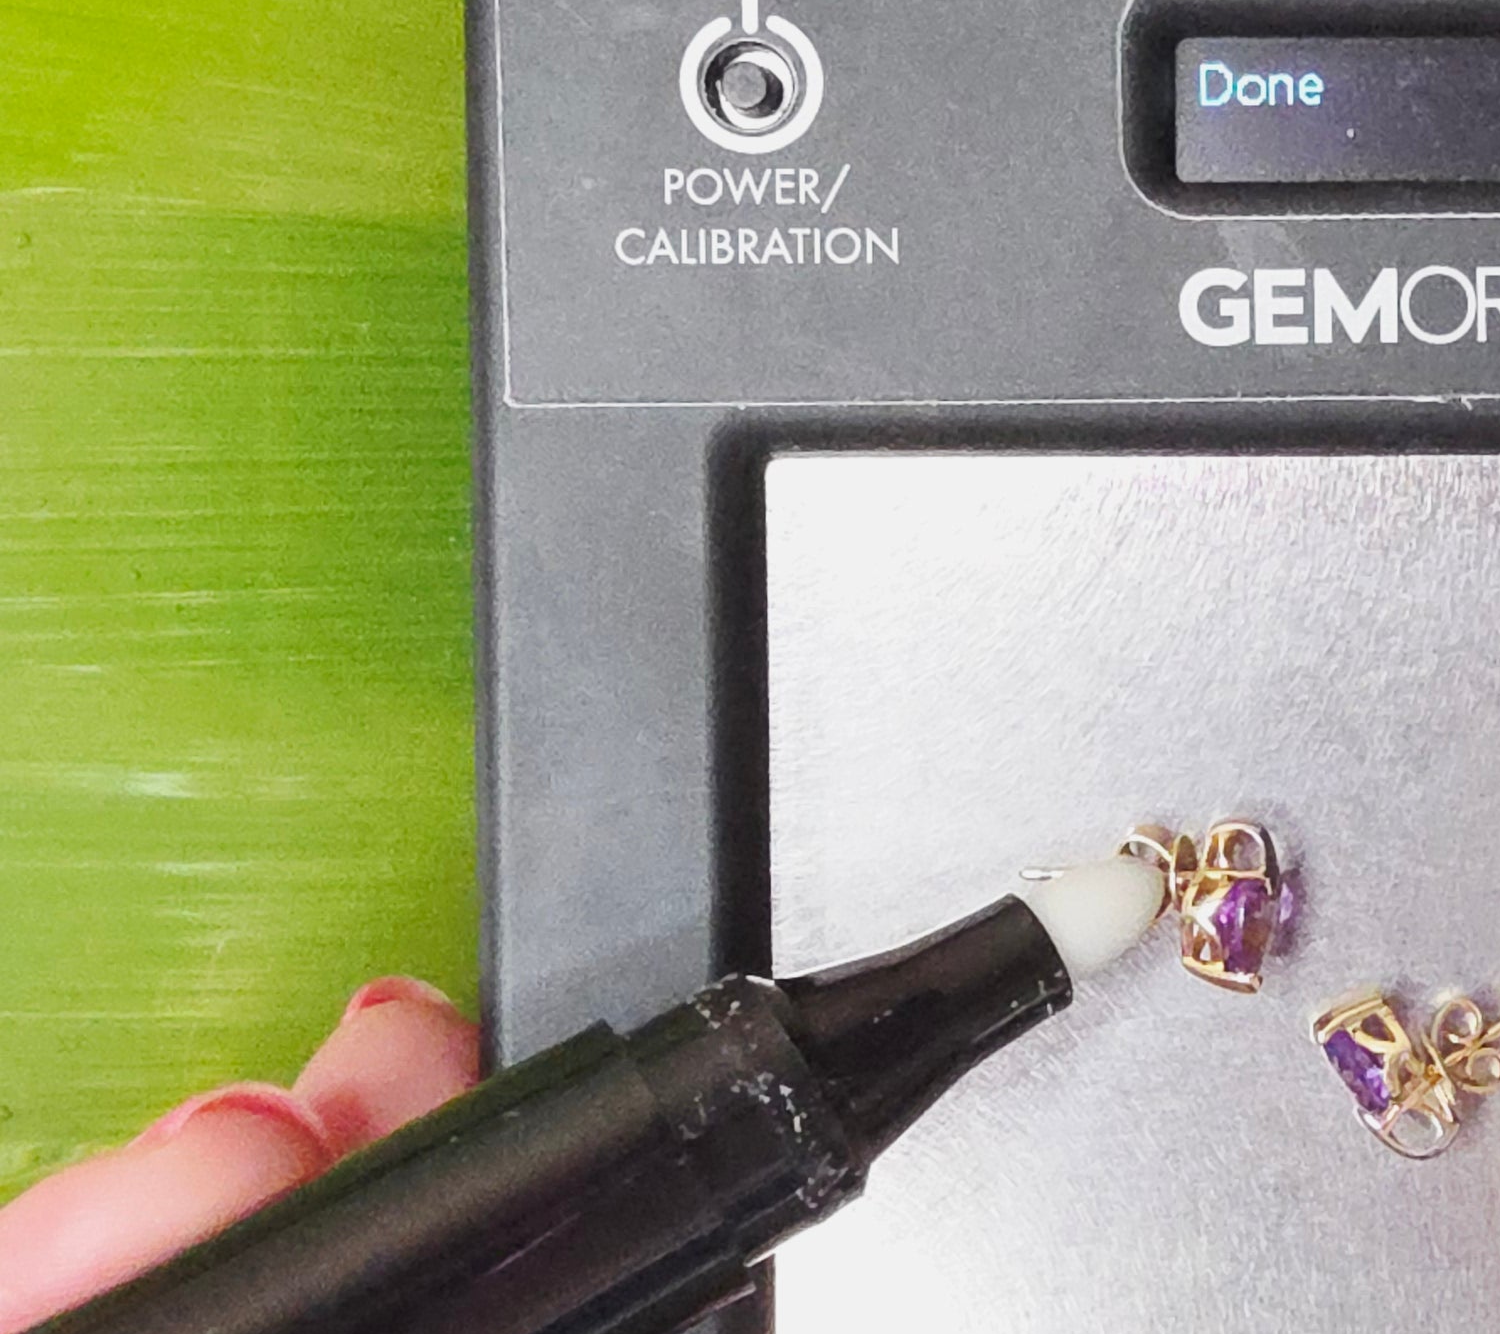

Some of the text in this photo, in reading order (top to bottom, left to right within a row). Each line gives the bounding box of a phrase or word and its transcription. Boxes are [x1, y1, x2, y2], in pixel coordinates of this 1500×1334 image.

[1197, 60, 1325, 108] Done
[662, 163, 851, 214] POWER/
[613, 226, 900, 267] CALIBRATION
